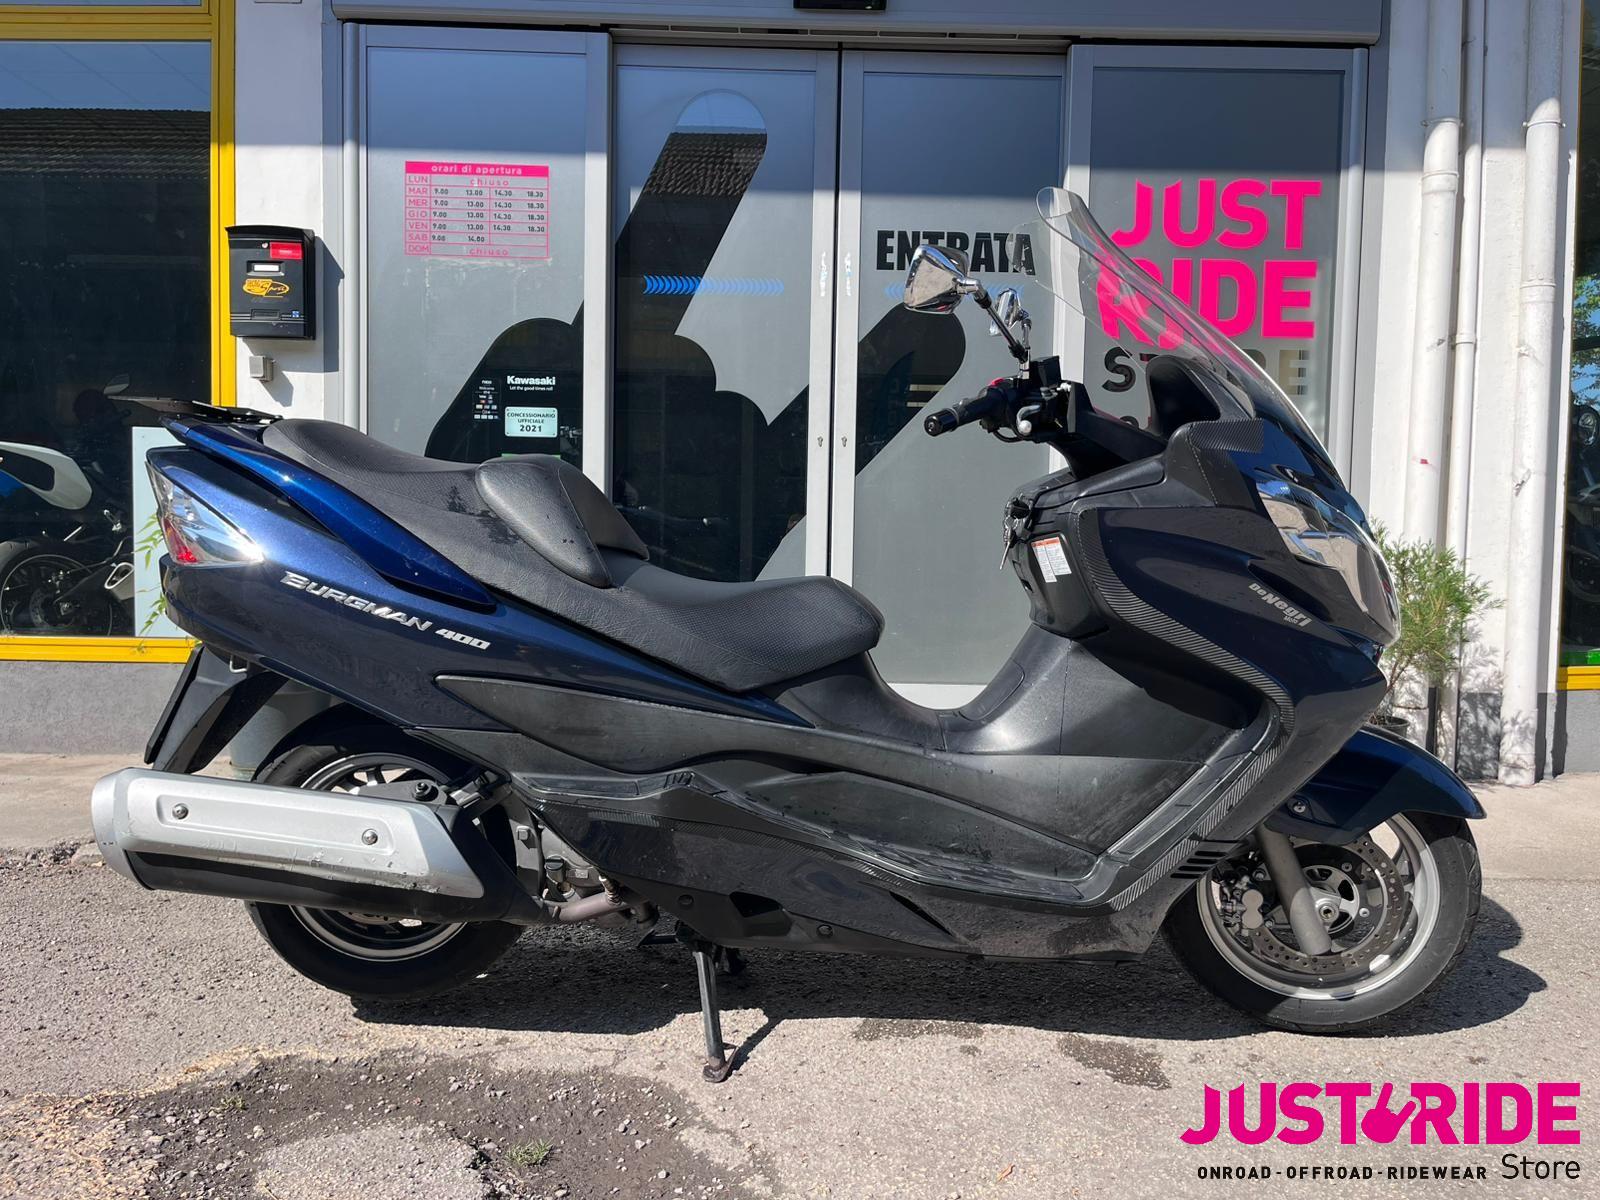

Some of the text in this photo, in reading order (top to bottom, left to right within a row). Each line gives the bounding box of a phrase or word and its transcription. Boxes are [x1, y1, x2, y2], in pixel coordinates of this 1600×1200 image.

[431, 165, 523, 176] orari di apertura
[408, 175, 428, 184] LUN
[408, 187, 428, 195] MAR
[1110, 179, 1323, 250] JUST
[408, 233, 428, 241] SAB
[408, 244, 429, 252] DOM
[1096, 256, 1318, 349] RIDE
[506, 375, 556, 386] Kawasaki
[280, 571, 491, 650] BURGMAN 400
